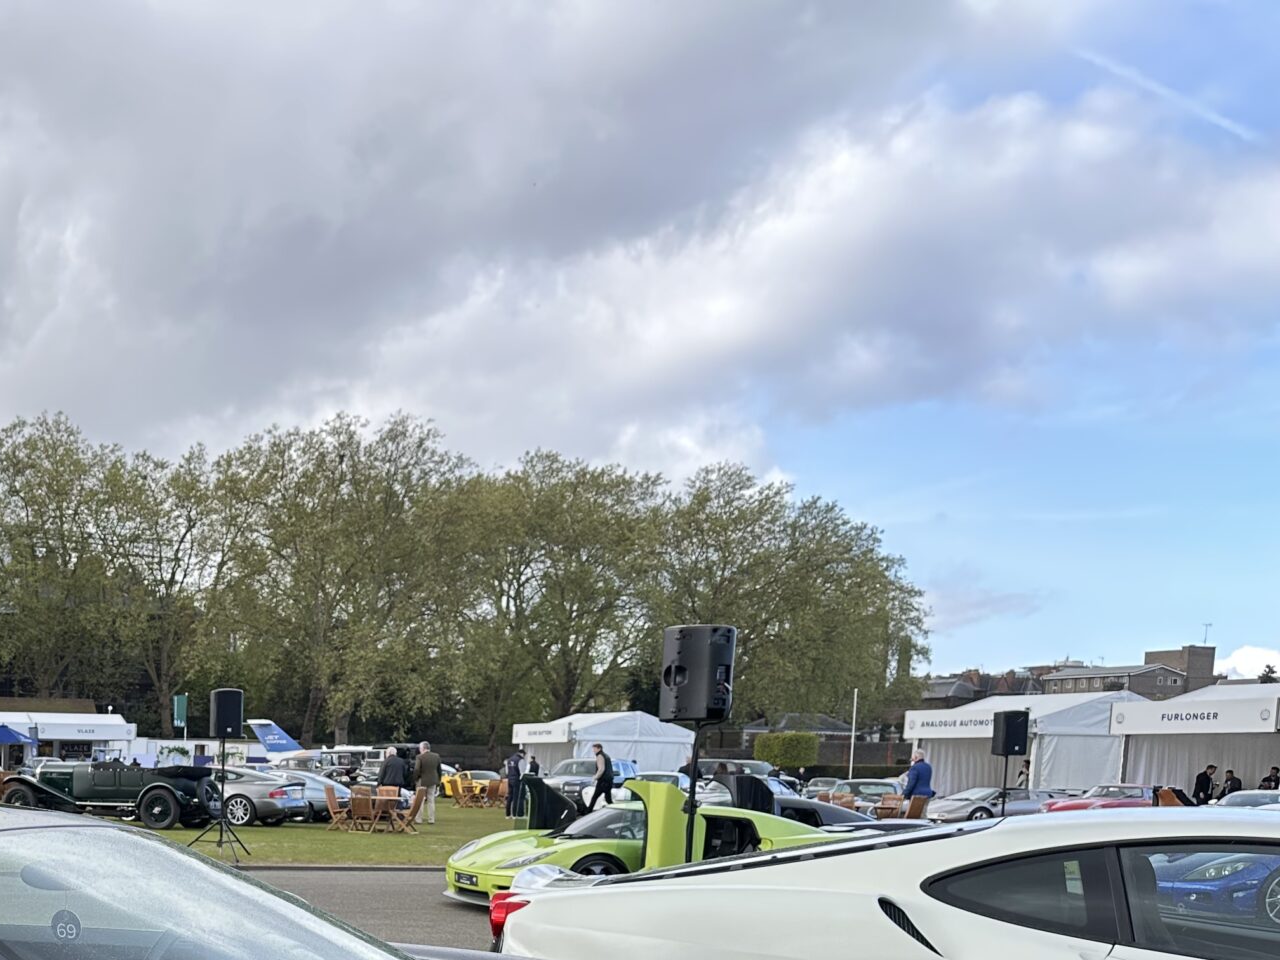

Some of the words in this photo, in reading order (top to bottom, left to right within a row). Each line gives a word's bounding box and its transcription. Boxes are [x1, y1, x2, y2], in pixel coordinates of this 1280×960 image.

[1161, 712, 1219, 721] FURLONGER
[959, 719, 994, 727] AUTOMOT
[57, 923, 76, 939] 69
